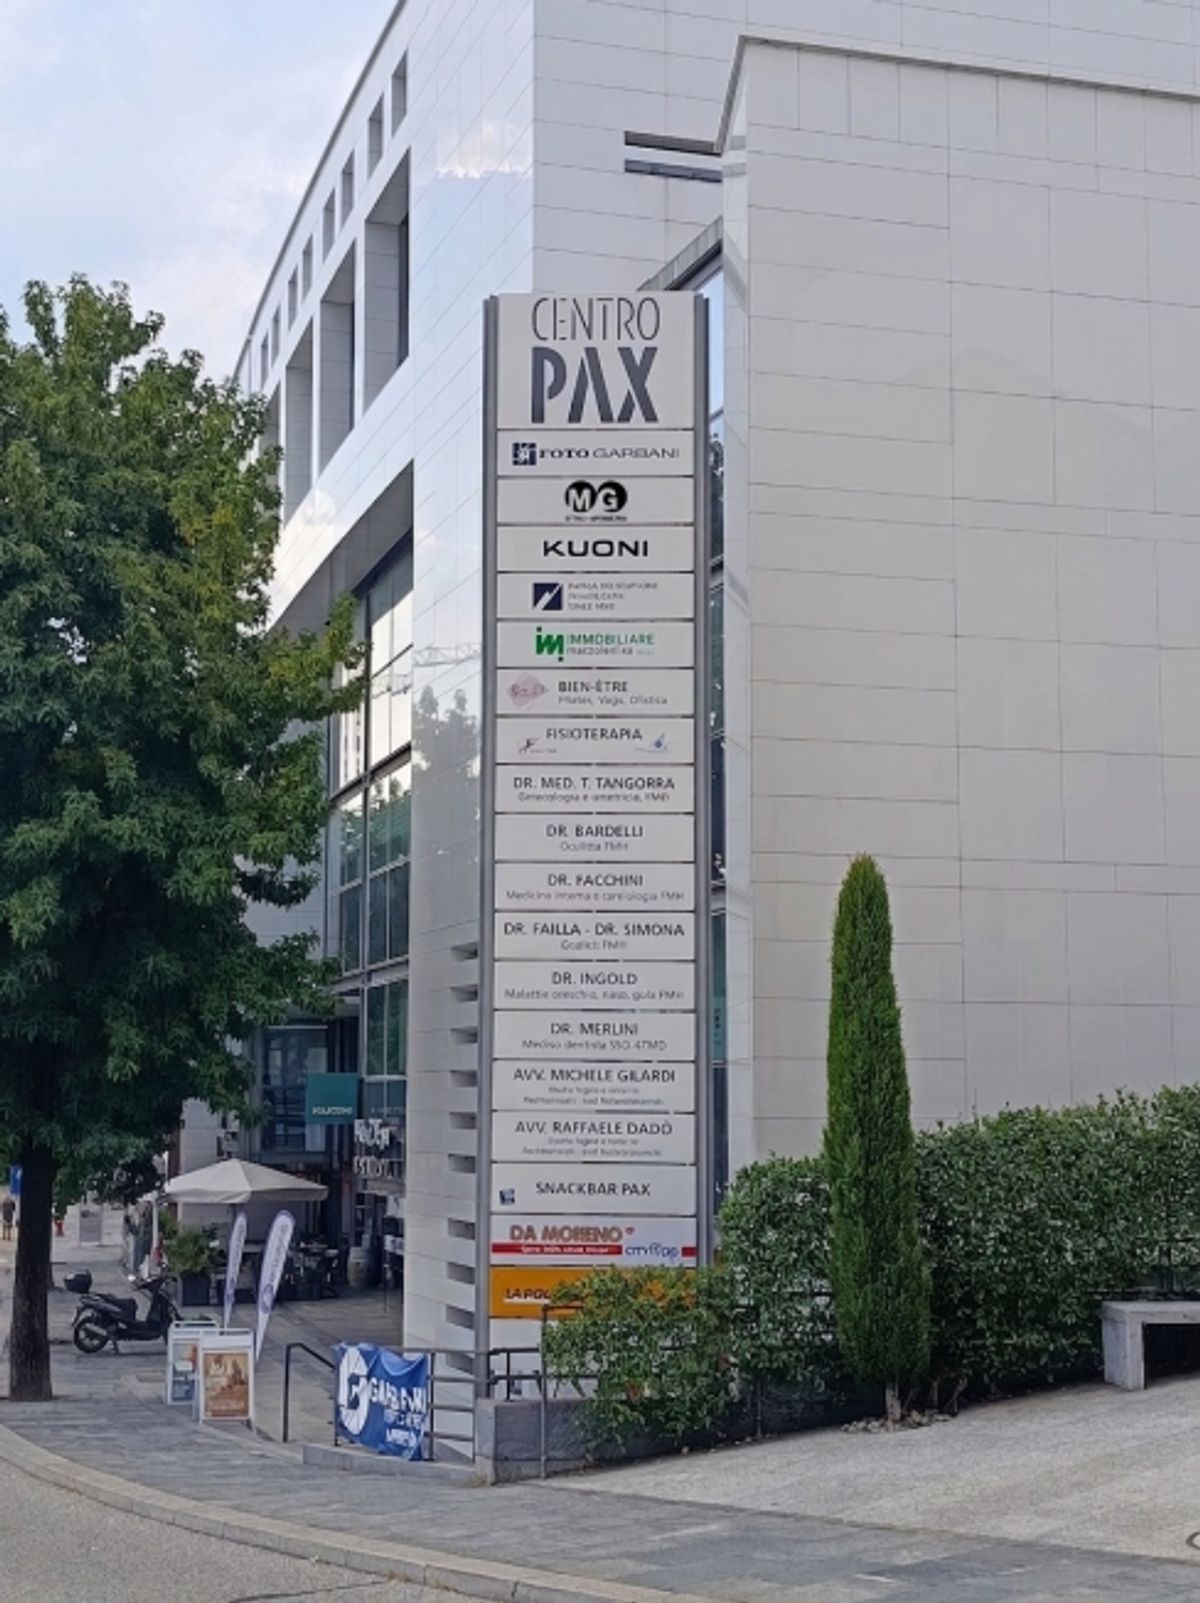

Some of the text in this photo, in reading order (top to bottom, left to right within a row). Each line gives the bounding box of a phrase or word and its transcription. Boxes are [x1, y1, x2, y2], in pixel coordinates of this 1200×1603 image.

[531, 297, 660, 341] CENTRO
[531, 347, 659, 423] PAX
[593, 448, 680, 459] GARBANI
[565, 480, 628, 512] MG
[543, 540, 649, 557] KUONI
[567, 634, 654, 645] IMMOBILIARE
[558, 677, 628, 692] BIEN-ÊTRE
[546, 727, 643, 740] FISIOTERAPIA
[513, 777, 676, 790] DR. MED. T. TANGORRA
[546, 825, 643, 837] DR. BARDELLI
[547, 873, 643, 887] DR. FACCHINI
[504, 922, 526, 936] DR.
[533, 922, 581, 936] FAILLA
[595, 922, 618, 936] DR.
[624, 922, 685, 936] SIMONA
[552, 972, 638, 986] DR. INGOLD
[551, 1023, 638, 1036] DR. MERLINI
[514, 1068, 675, 1083] AVV. MICHELE GILARDI
[515, 1118, 673, 1135] AVV. RAFFAELE DADÒ
[536, 1182, 651, 1197] SNACKBAR PAX
[510, 1225, 623, 1243] DA MORENO
[506, 1288, 522, 1299] LA
